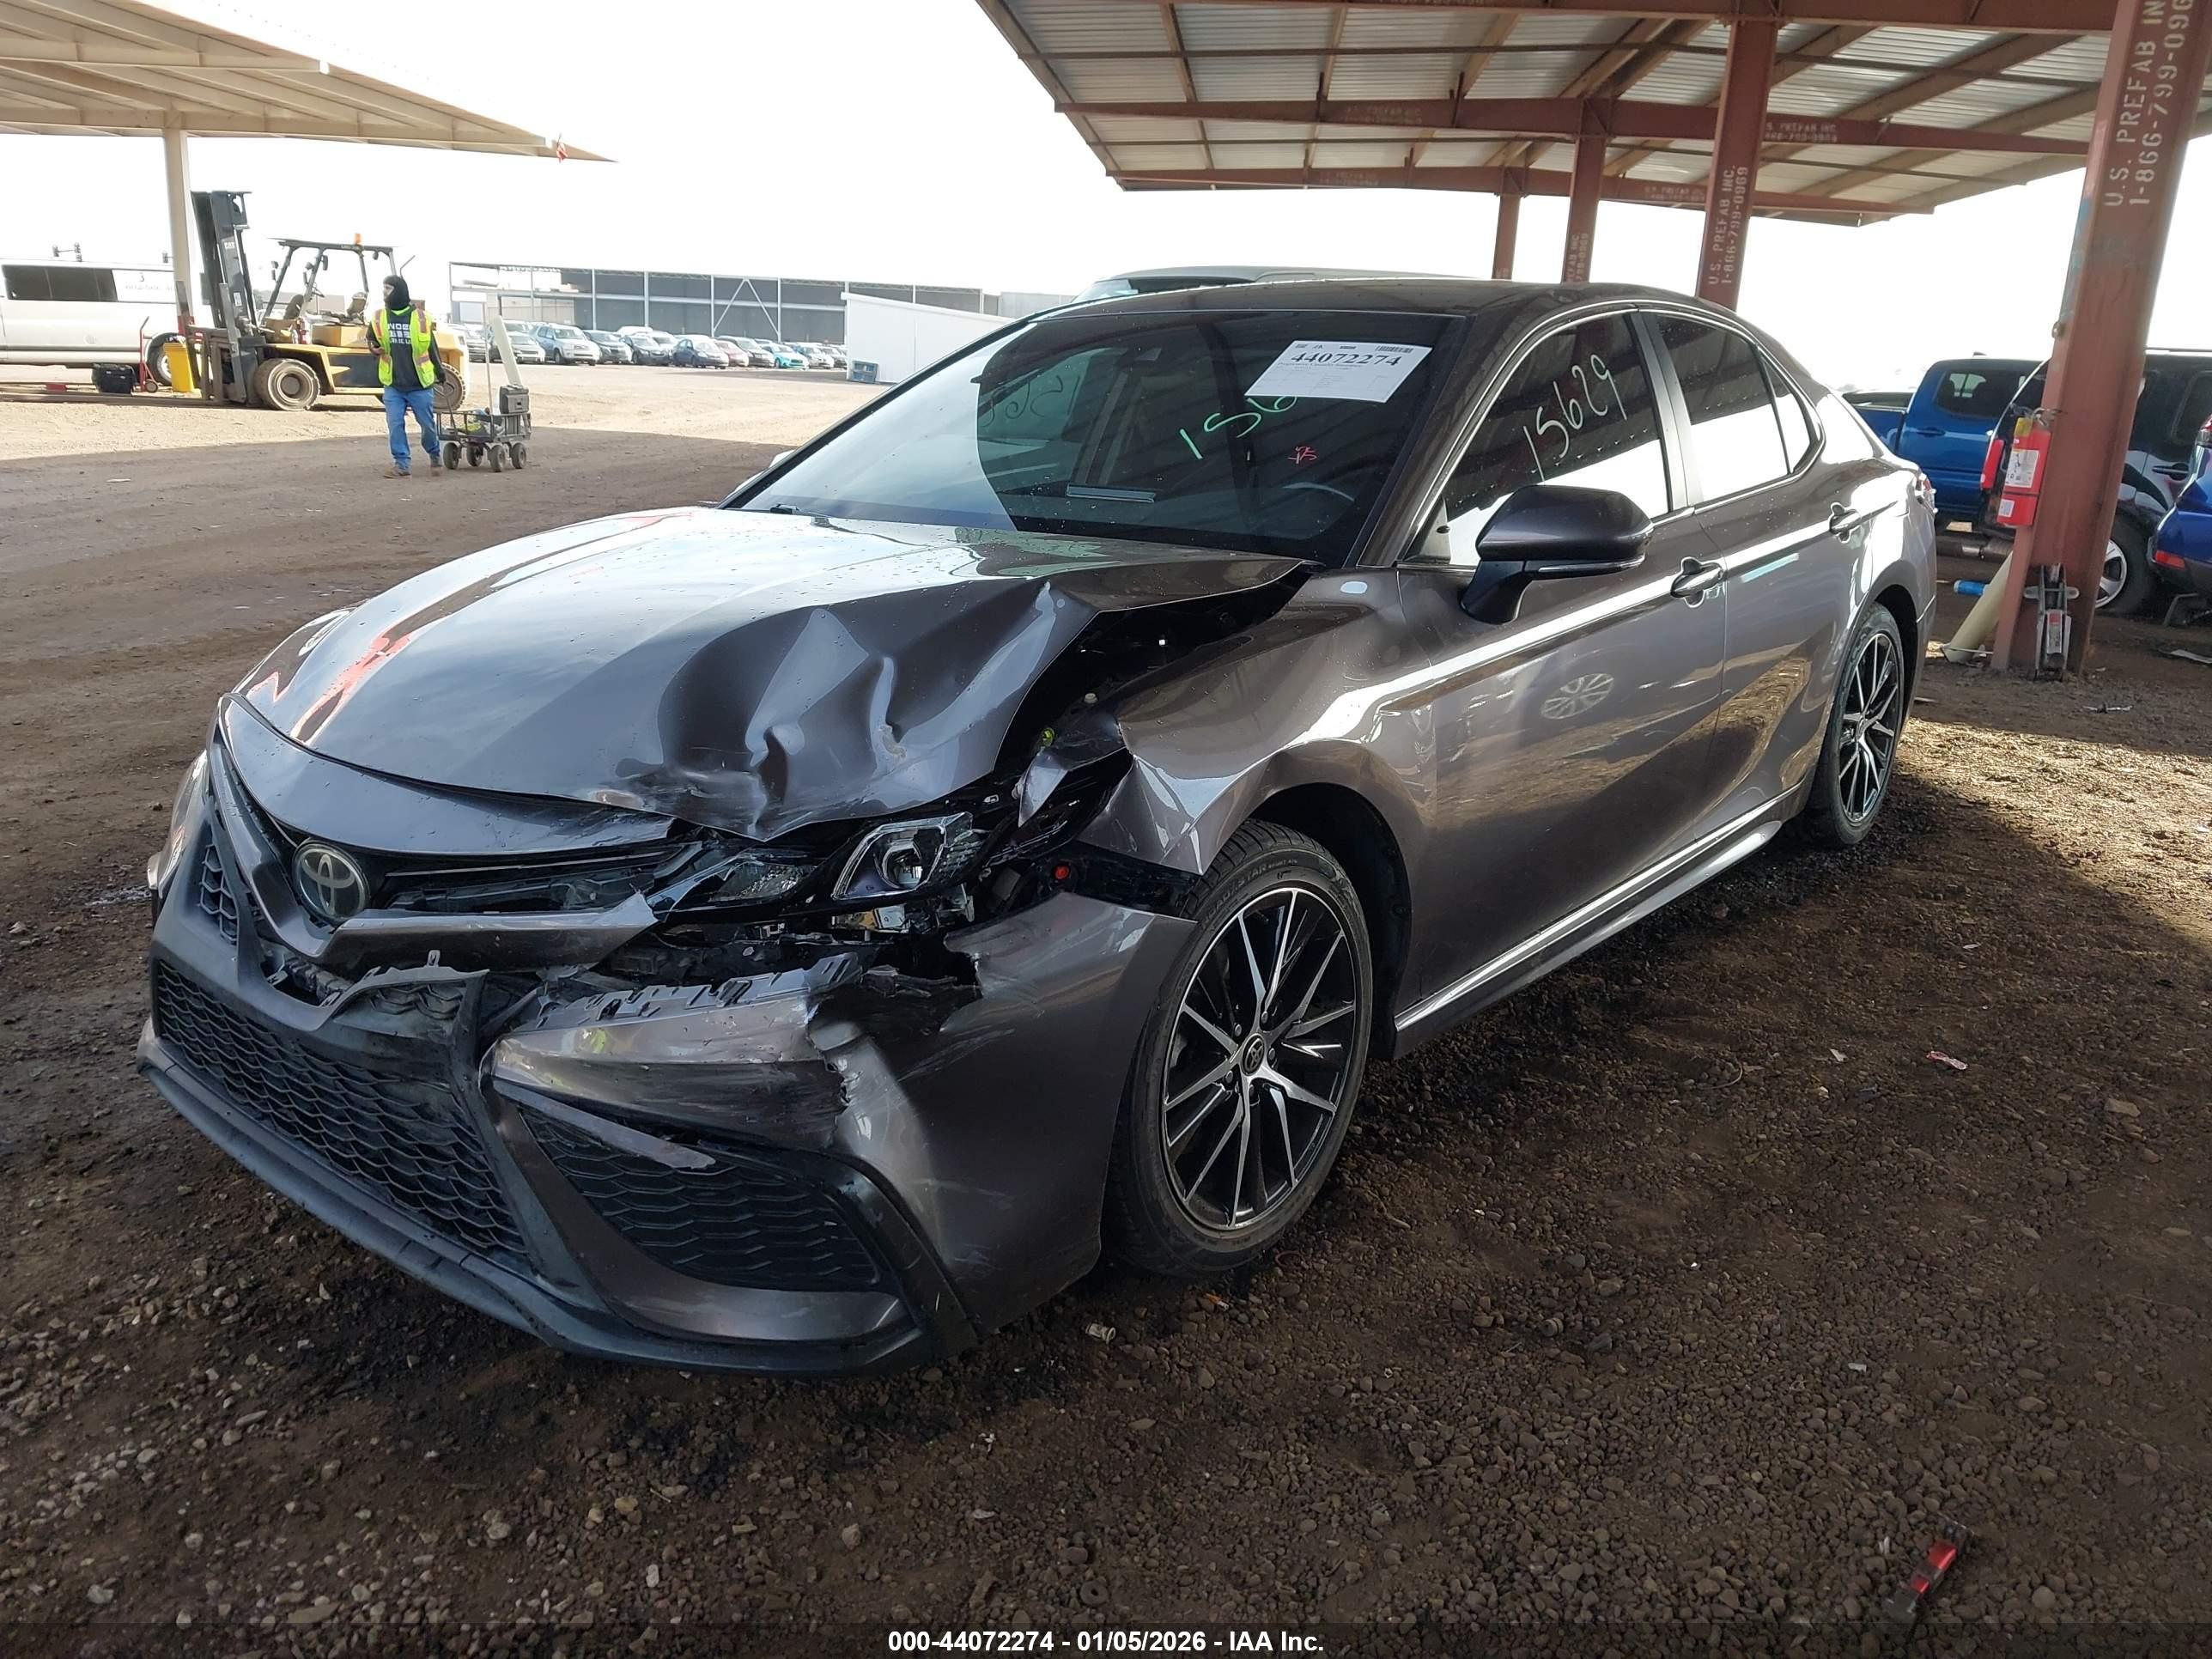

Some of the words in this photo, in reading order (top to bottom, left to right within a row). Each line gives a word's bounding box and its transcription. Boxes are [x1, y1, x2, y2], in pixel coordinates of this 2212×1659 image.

[2116, 41, 2156, 143] PREFAB
[2104, 159, 2132, 206] U.S.
[1712, 198, 1731, 252] PREFAB
[1721, 166, 1749, 284] 1-866-799-0969
[1708, 259, 1723, 285] U.S.
[1291, 352, 1402, 367] 44072274
[1522, 354, 1627, 482] 15629
